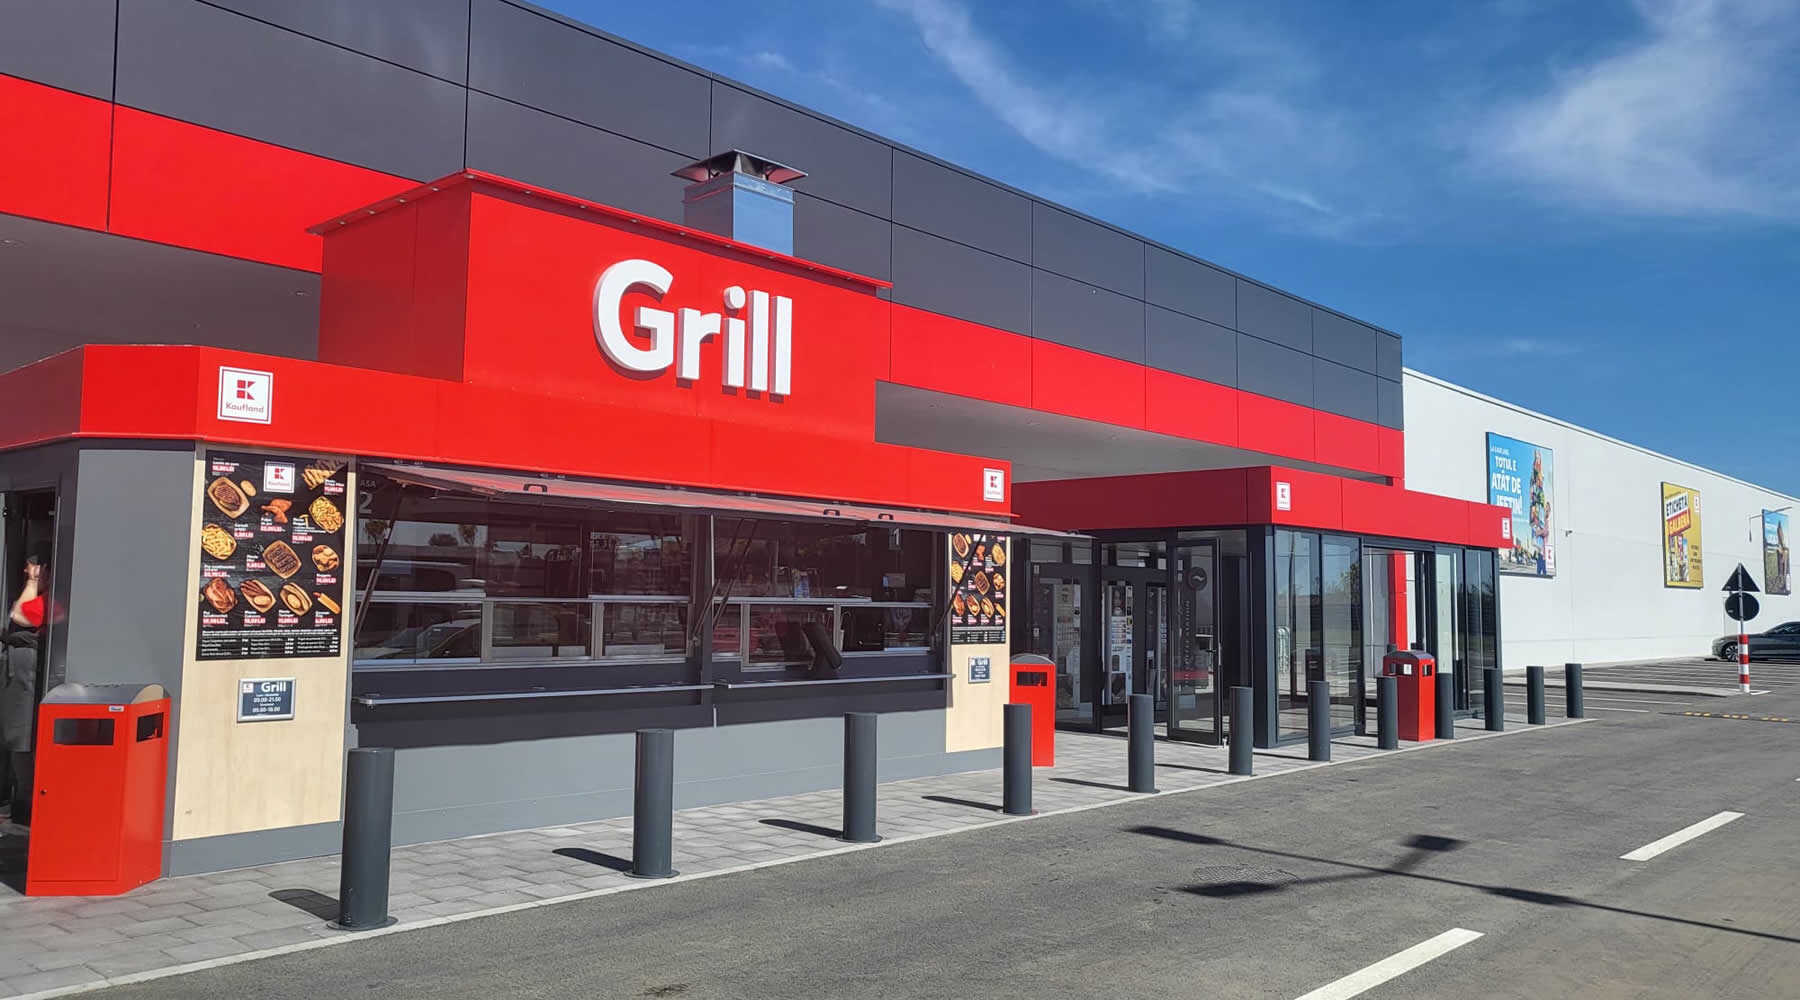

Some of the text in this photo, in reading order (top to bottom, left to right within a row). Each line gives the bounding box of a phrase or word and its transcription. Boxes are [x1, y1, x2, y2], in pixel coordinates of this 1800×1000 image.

[593, 259, 792, 395] Grill
[226, 402, 264, 413] Kaufland
[1511, 476, 1521, 495] DE
[359, 491, 373, 514] 2
[261, 682, 287, 693] Grill
